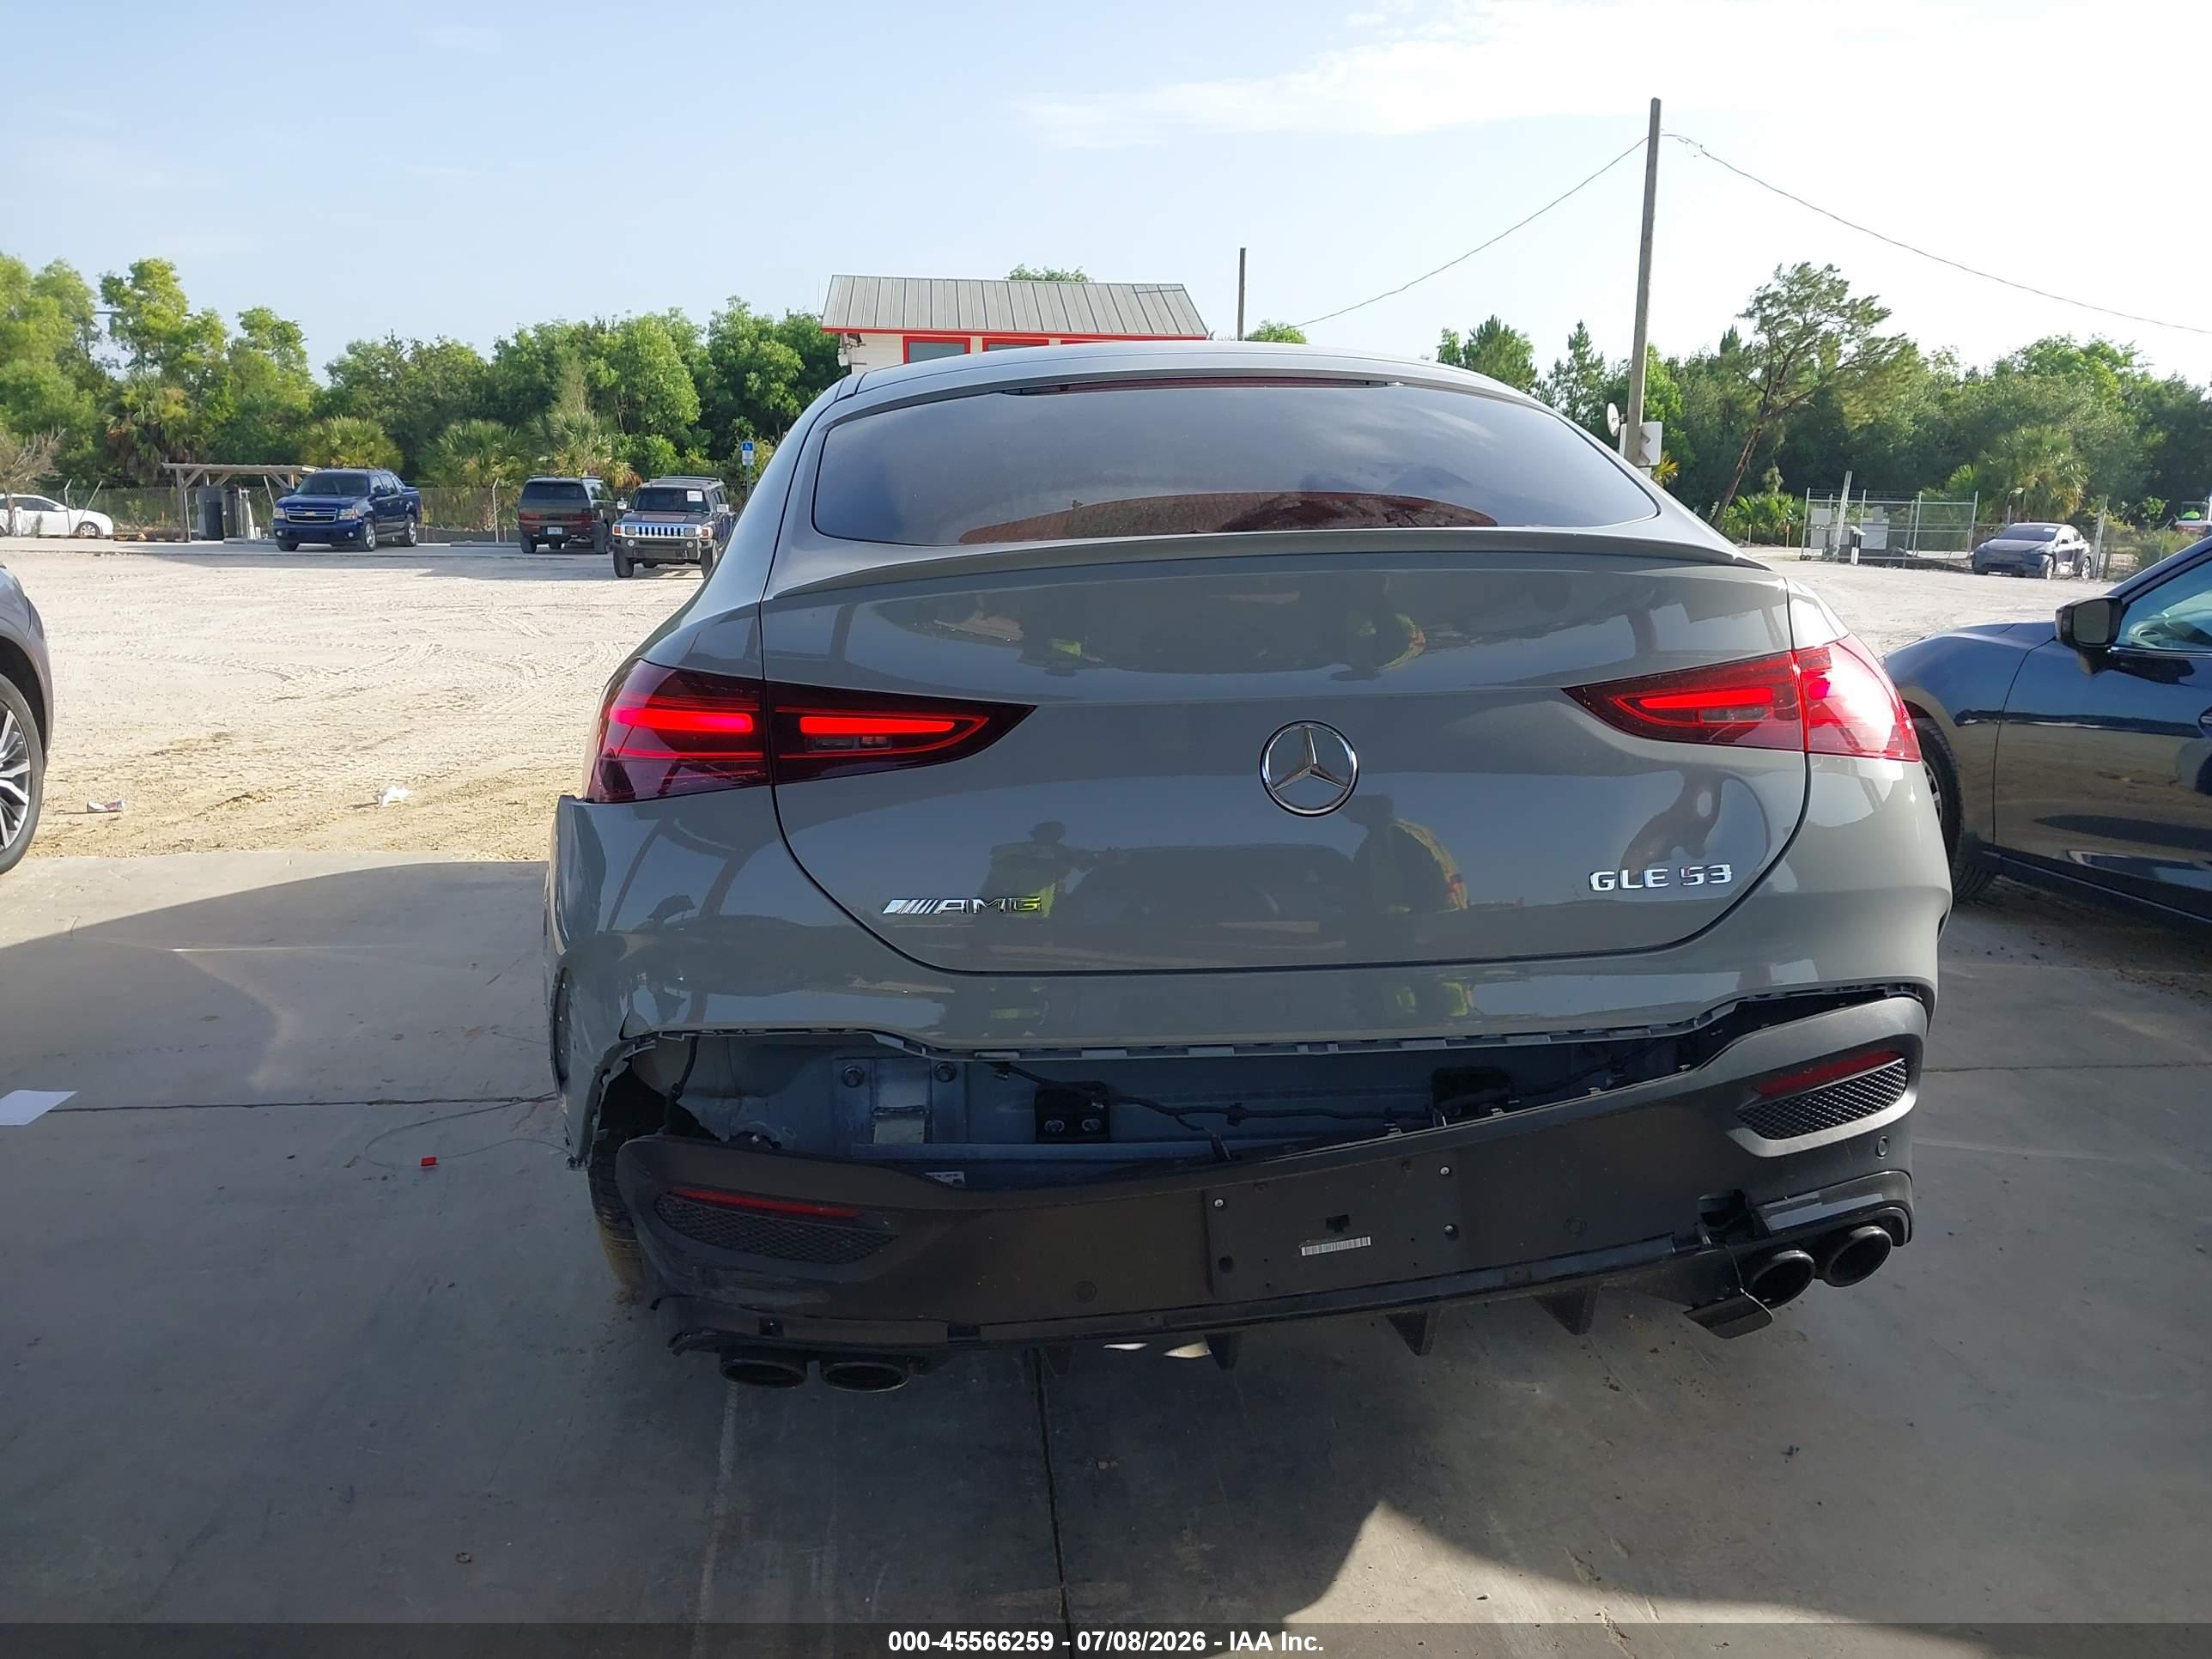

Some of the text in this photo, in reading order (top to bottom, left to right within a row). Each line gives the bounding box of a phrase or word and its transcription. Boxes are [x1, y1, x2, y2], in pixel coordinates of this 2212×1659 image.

[1589, 863, 1732, 891] GLE 53
[933, 898, 1042, 915] AMG
